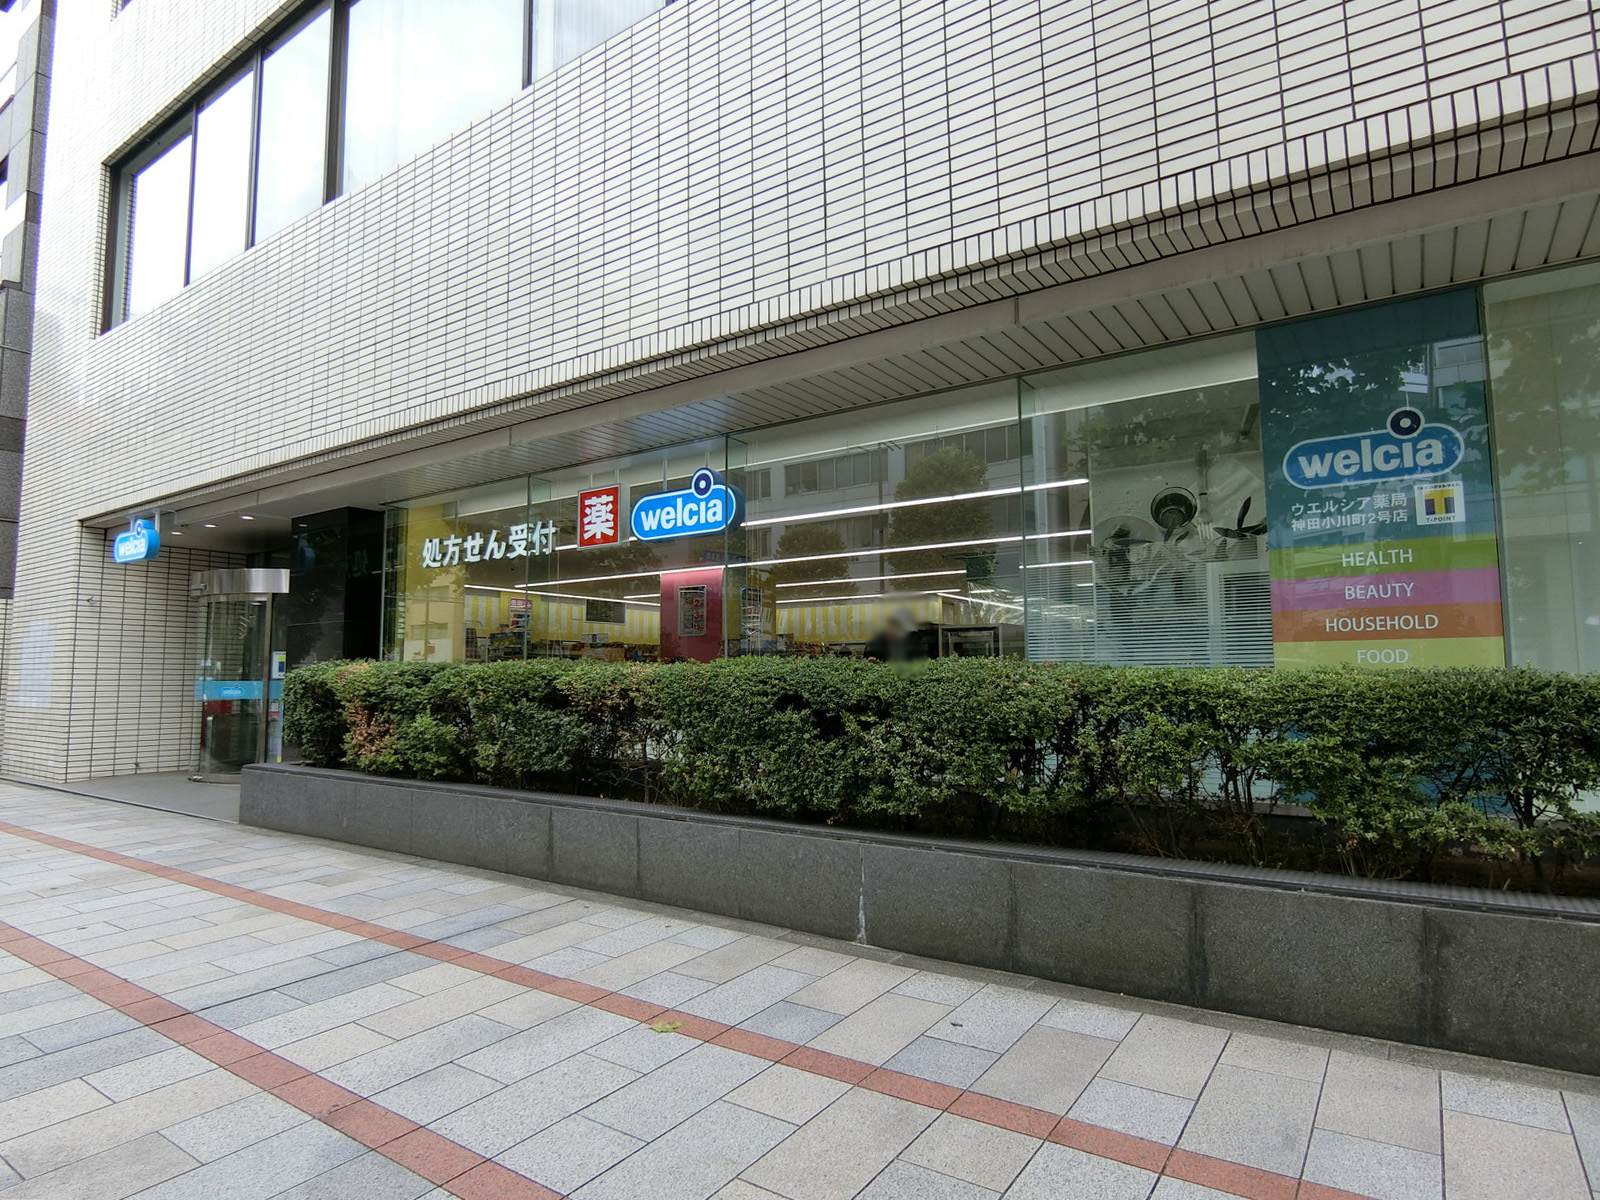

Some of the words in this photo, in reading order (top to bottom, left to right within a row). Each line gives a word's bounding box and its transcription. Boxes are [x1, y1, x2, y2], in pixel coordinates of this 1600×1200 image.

[1298, 438, 1443, 479] welcia
[640, 495, 724, 532] welcia
[1290, 493, 1408, 516] ウエルシア薬局
[583, 494, 615, 540] 薬
[1291, 509, 1408, 531] 神田小川町2号店
[118, 536, 146, 557] welcia
[421, 519, 557, 569] 処方せん受付
[1341, 548, 1413, 567] HEALTH
[1344, 583, 1414, 600] BEAUTY
[1325, 614, 1439, 632] HOUSEHOLD
[1356, 648, 1409, 664] FOOD
